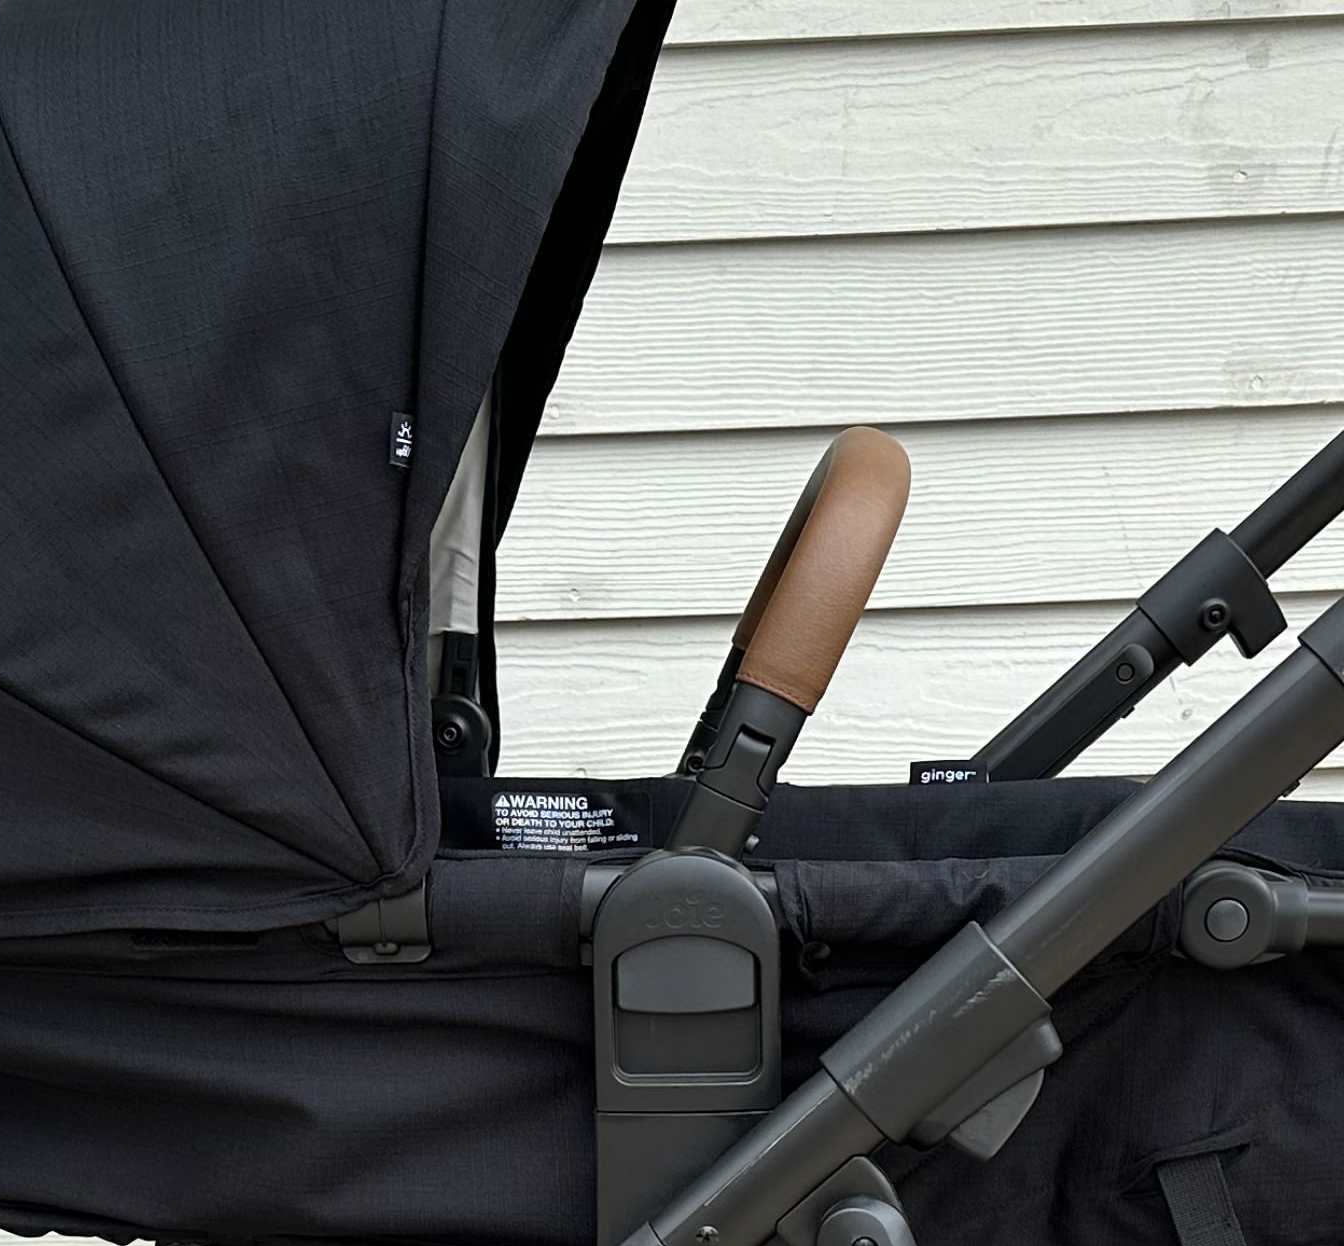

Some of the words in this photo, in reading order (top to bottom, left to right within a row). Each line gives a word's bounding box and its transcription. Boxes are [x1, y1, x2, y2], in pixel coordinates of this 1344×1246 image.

[509, 795, 588, 810] WARNING
[496, 809, 509, 817] TO
[510, 809, 538, 818] AVOID
[540, 810, 580, 819] SERIOUS
[581, 809, 613, 819] INJURY
[496, 818, 509, 826] OR
[511, 818, 542, 827] DEATH
[544, 819, 557, 828] TO
[558, 819, 585, 828] YOUR
